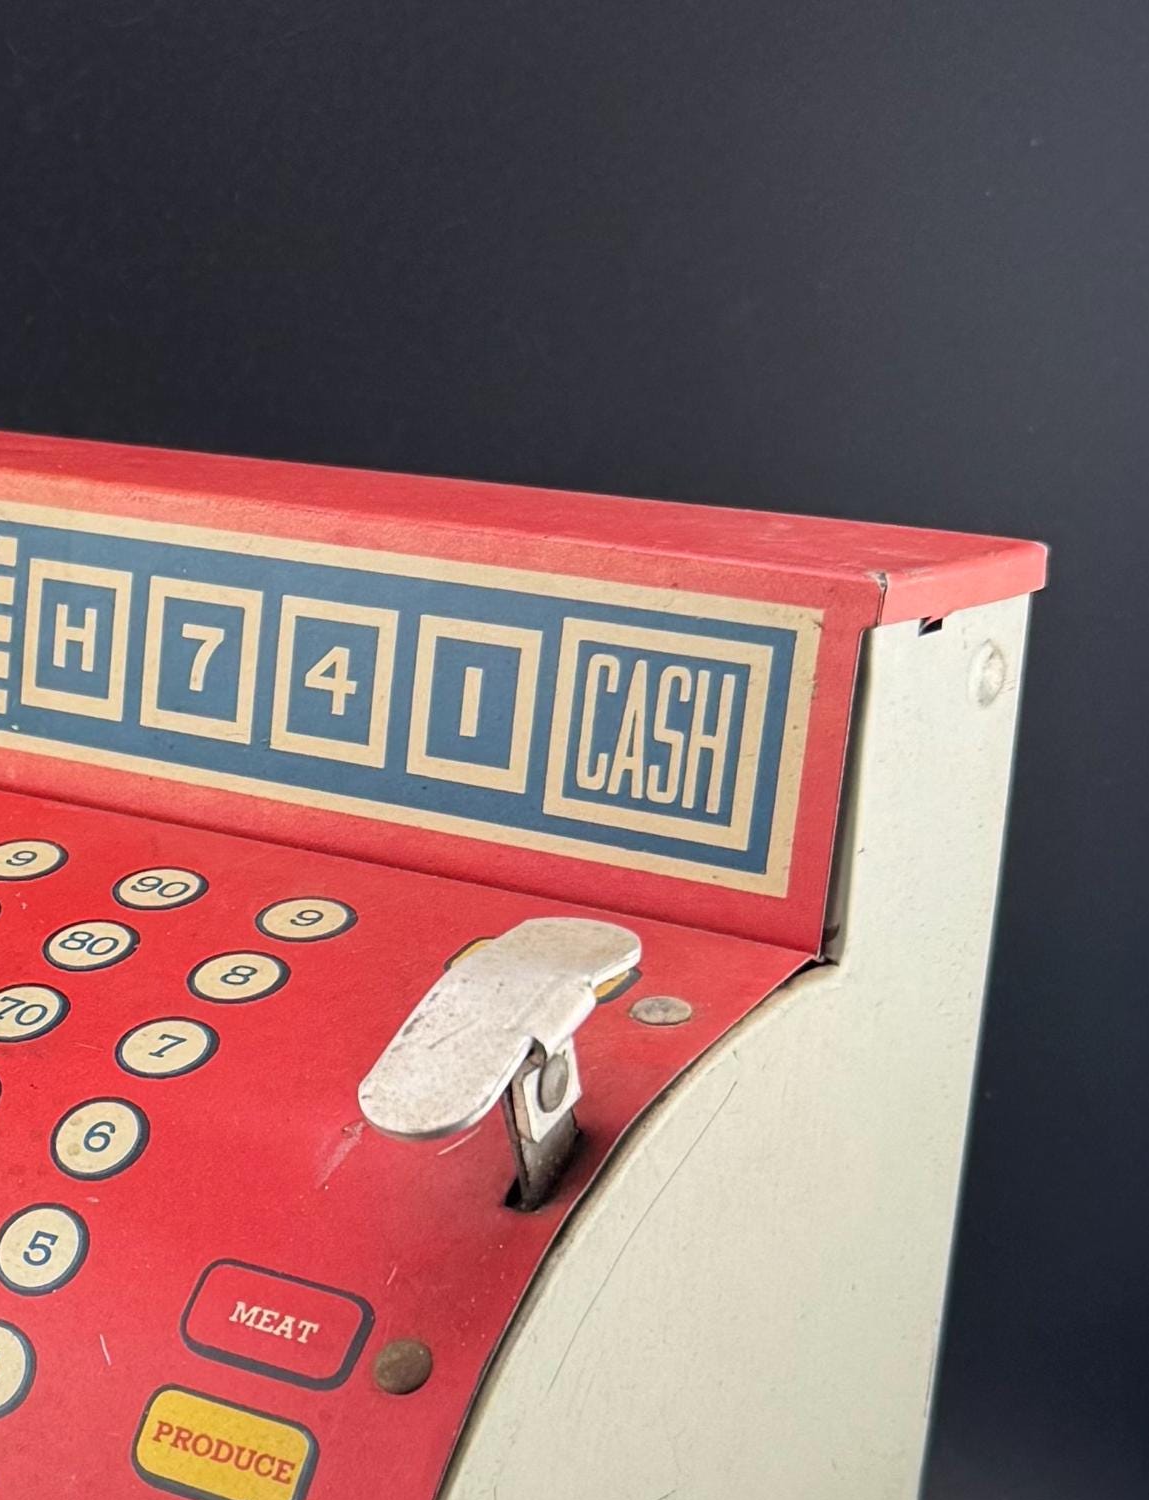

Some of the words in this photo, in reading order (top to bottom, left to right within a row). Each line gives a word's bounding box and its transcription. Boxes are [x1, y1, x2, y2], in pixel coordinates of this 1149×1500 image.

[52, 603, 98, 673] H
[181, 622, 226, 692] 7
[304, 645, 358, 716] 4
[576, 653, 737, 814] CASH
[5, 850, 38, 867] 9
[130, 875, 191, 899] 90
[289, 909, 325, 927] 9
[58, 930, 120, 956] 80
[219, 964, 259, 986] 8
[148, 1033, 188, 1058] 7
[83, 1120, 116, 1153] 6
[22, 1230, 59, 1267] 5
[228, 1301, 320, 1344] MEAT
[152, 1420, 296, 1485] PRODUCE
